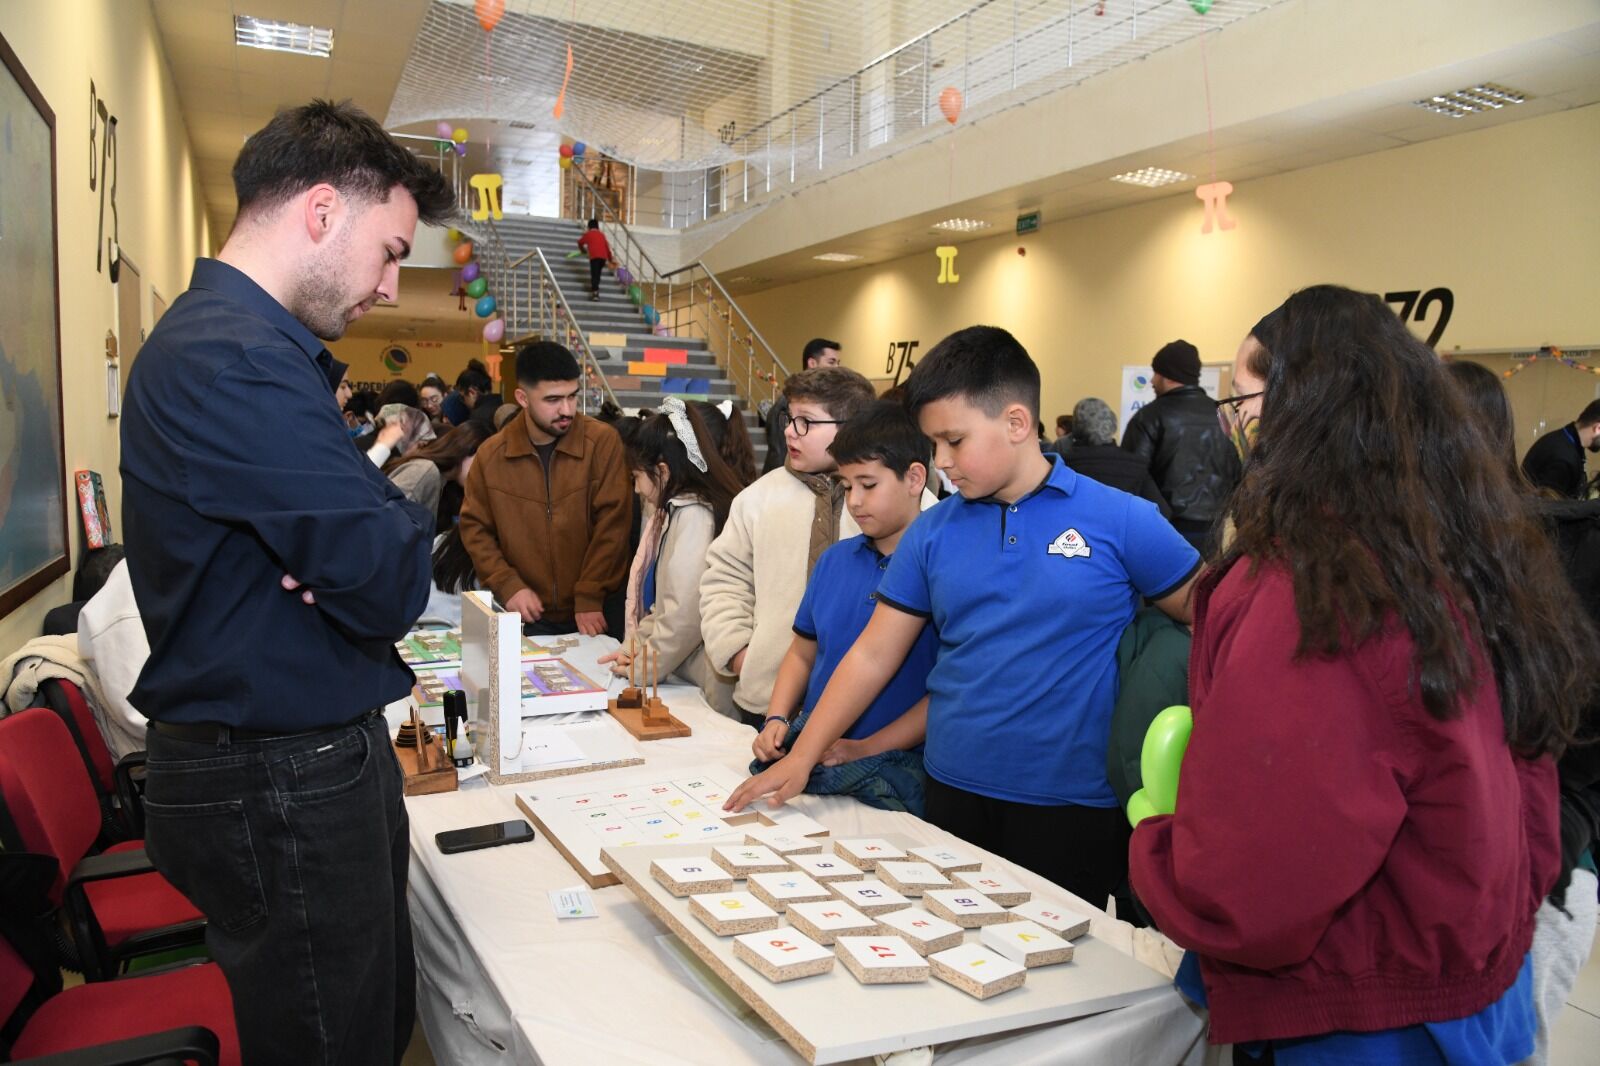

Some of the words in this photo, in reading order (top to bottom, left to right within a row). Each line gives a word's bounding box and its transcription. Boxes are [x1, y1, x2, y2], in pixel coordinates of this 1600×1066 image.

[1372, 287, 1454, 350] 72
[858, 889, 882, 898] 13
[954, 898, 978, 907] 18
[870, 945, 897, 958] 17
